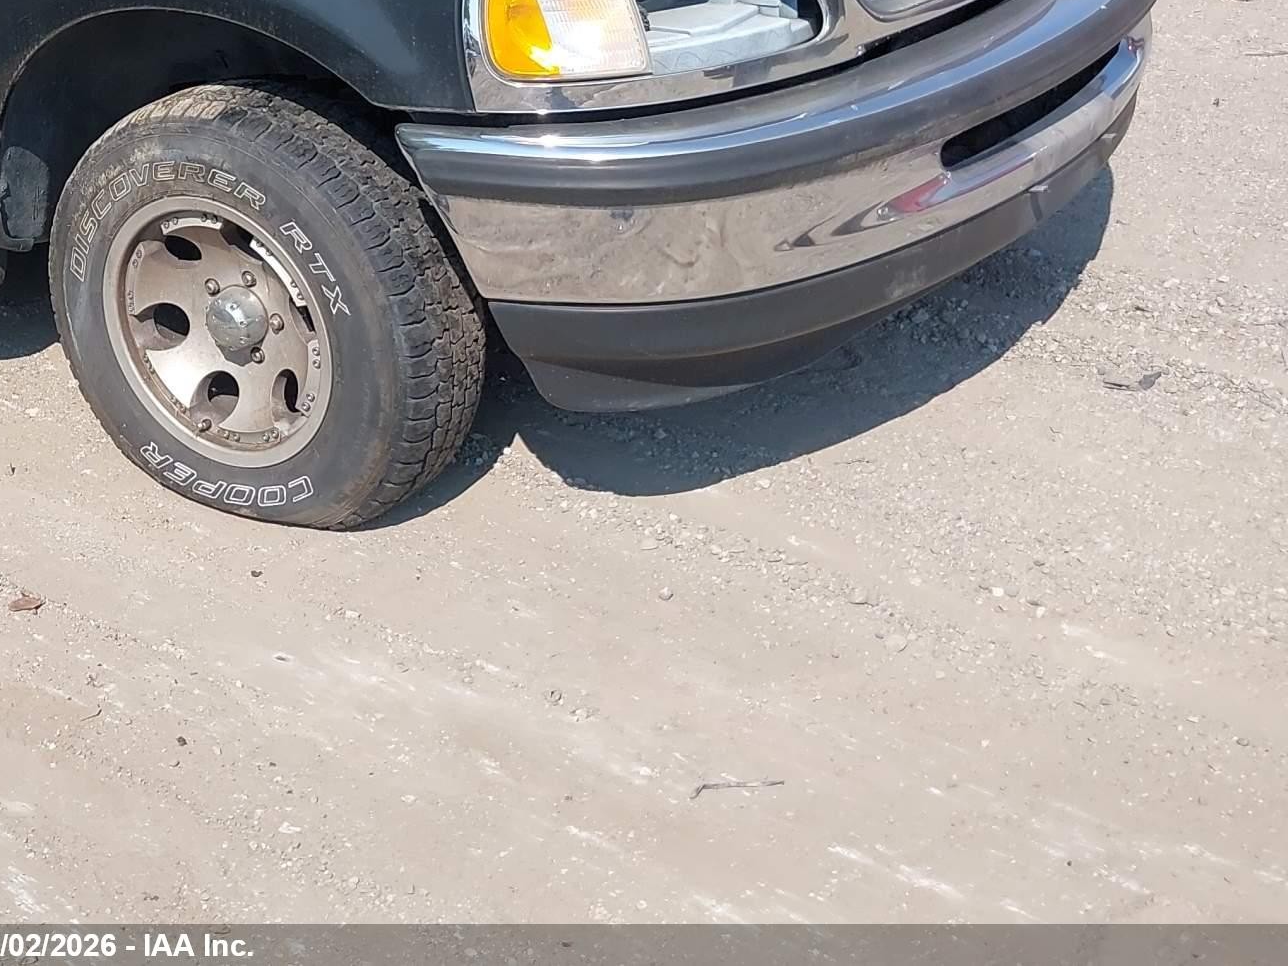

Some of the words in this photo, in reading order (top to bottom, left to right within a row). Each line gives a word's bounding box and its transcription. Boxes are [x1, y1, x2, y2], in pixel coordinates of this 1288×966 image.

[69, 160, 267, 283] DISCOVERER
[279, 220, 352, 316] RTX
[139, 440, 315, 508] COOPER
